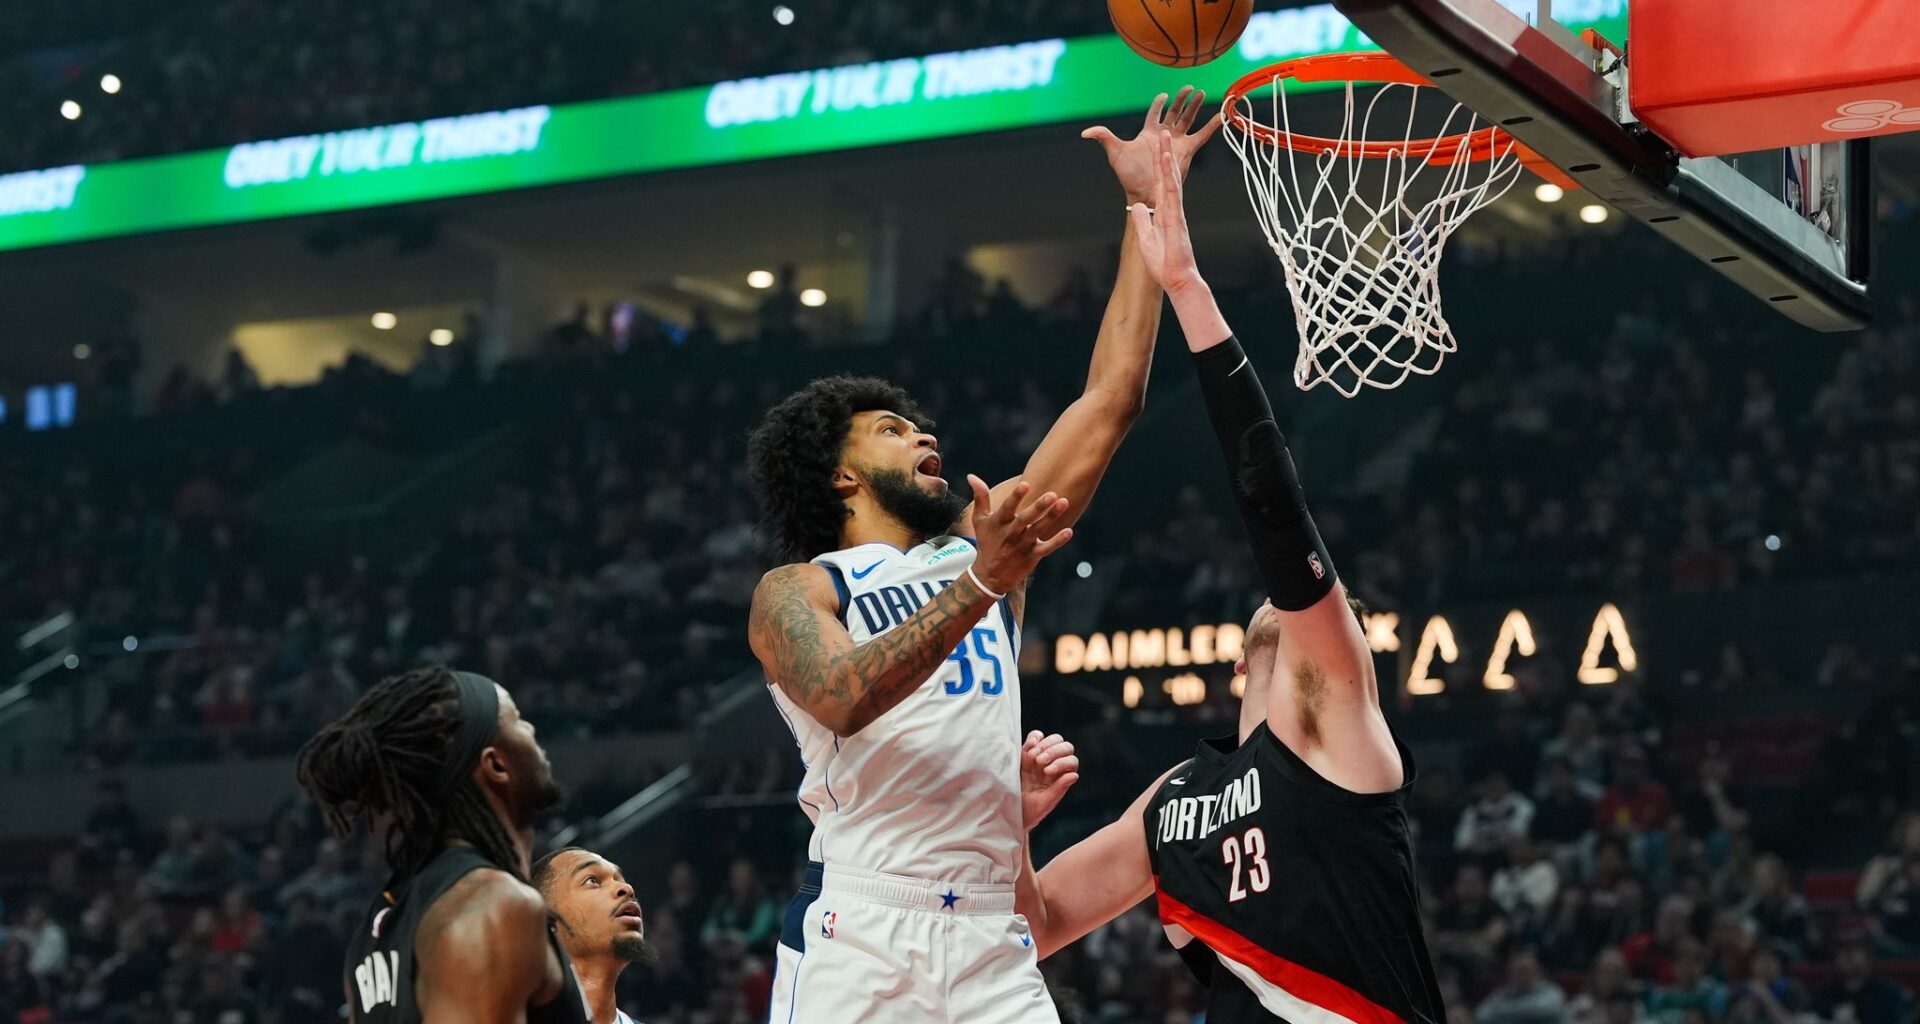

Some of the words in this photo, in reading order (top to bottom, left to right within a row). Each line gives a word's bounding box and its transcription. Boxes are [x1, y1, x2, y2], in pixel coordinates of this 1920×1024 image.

[852, 579, 958, 636] DAL
[944, 628, 1003, 696] 35
[1055, 622, 1245, 674] DAIMLER
[1156, 767, 1262, 851] PORTLAND
[1222, 826, 1272, 903] 23
